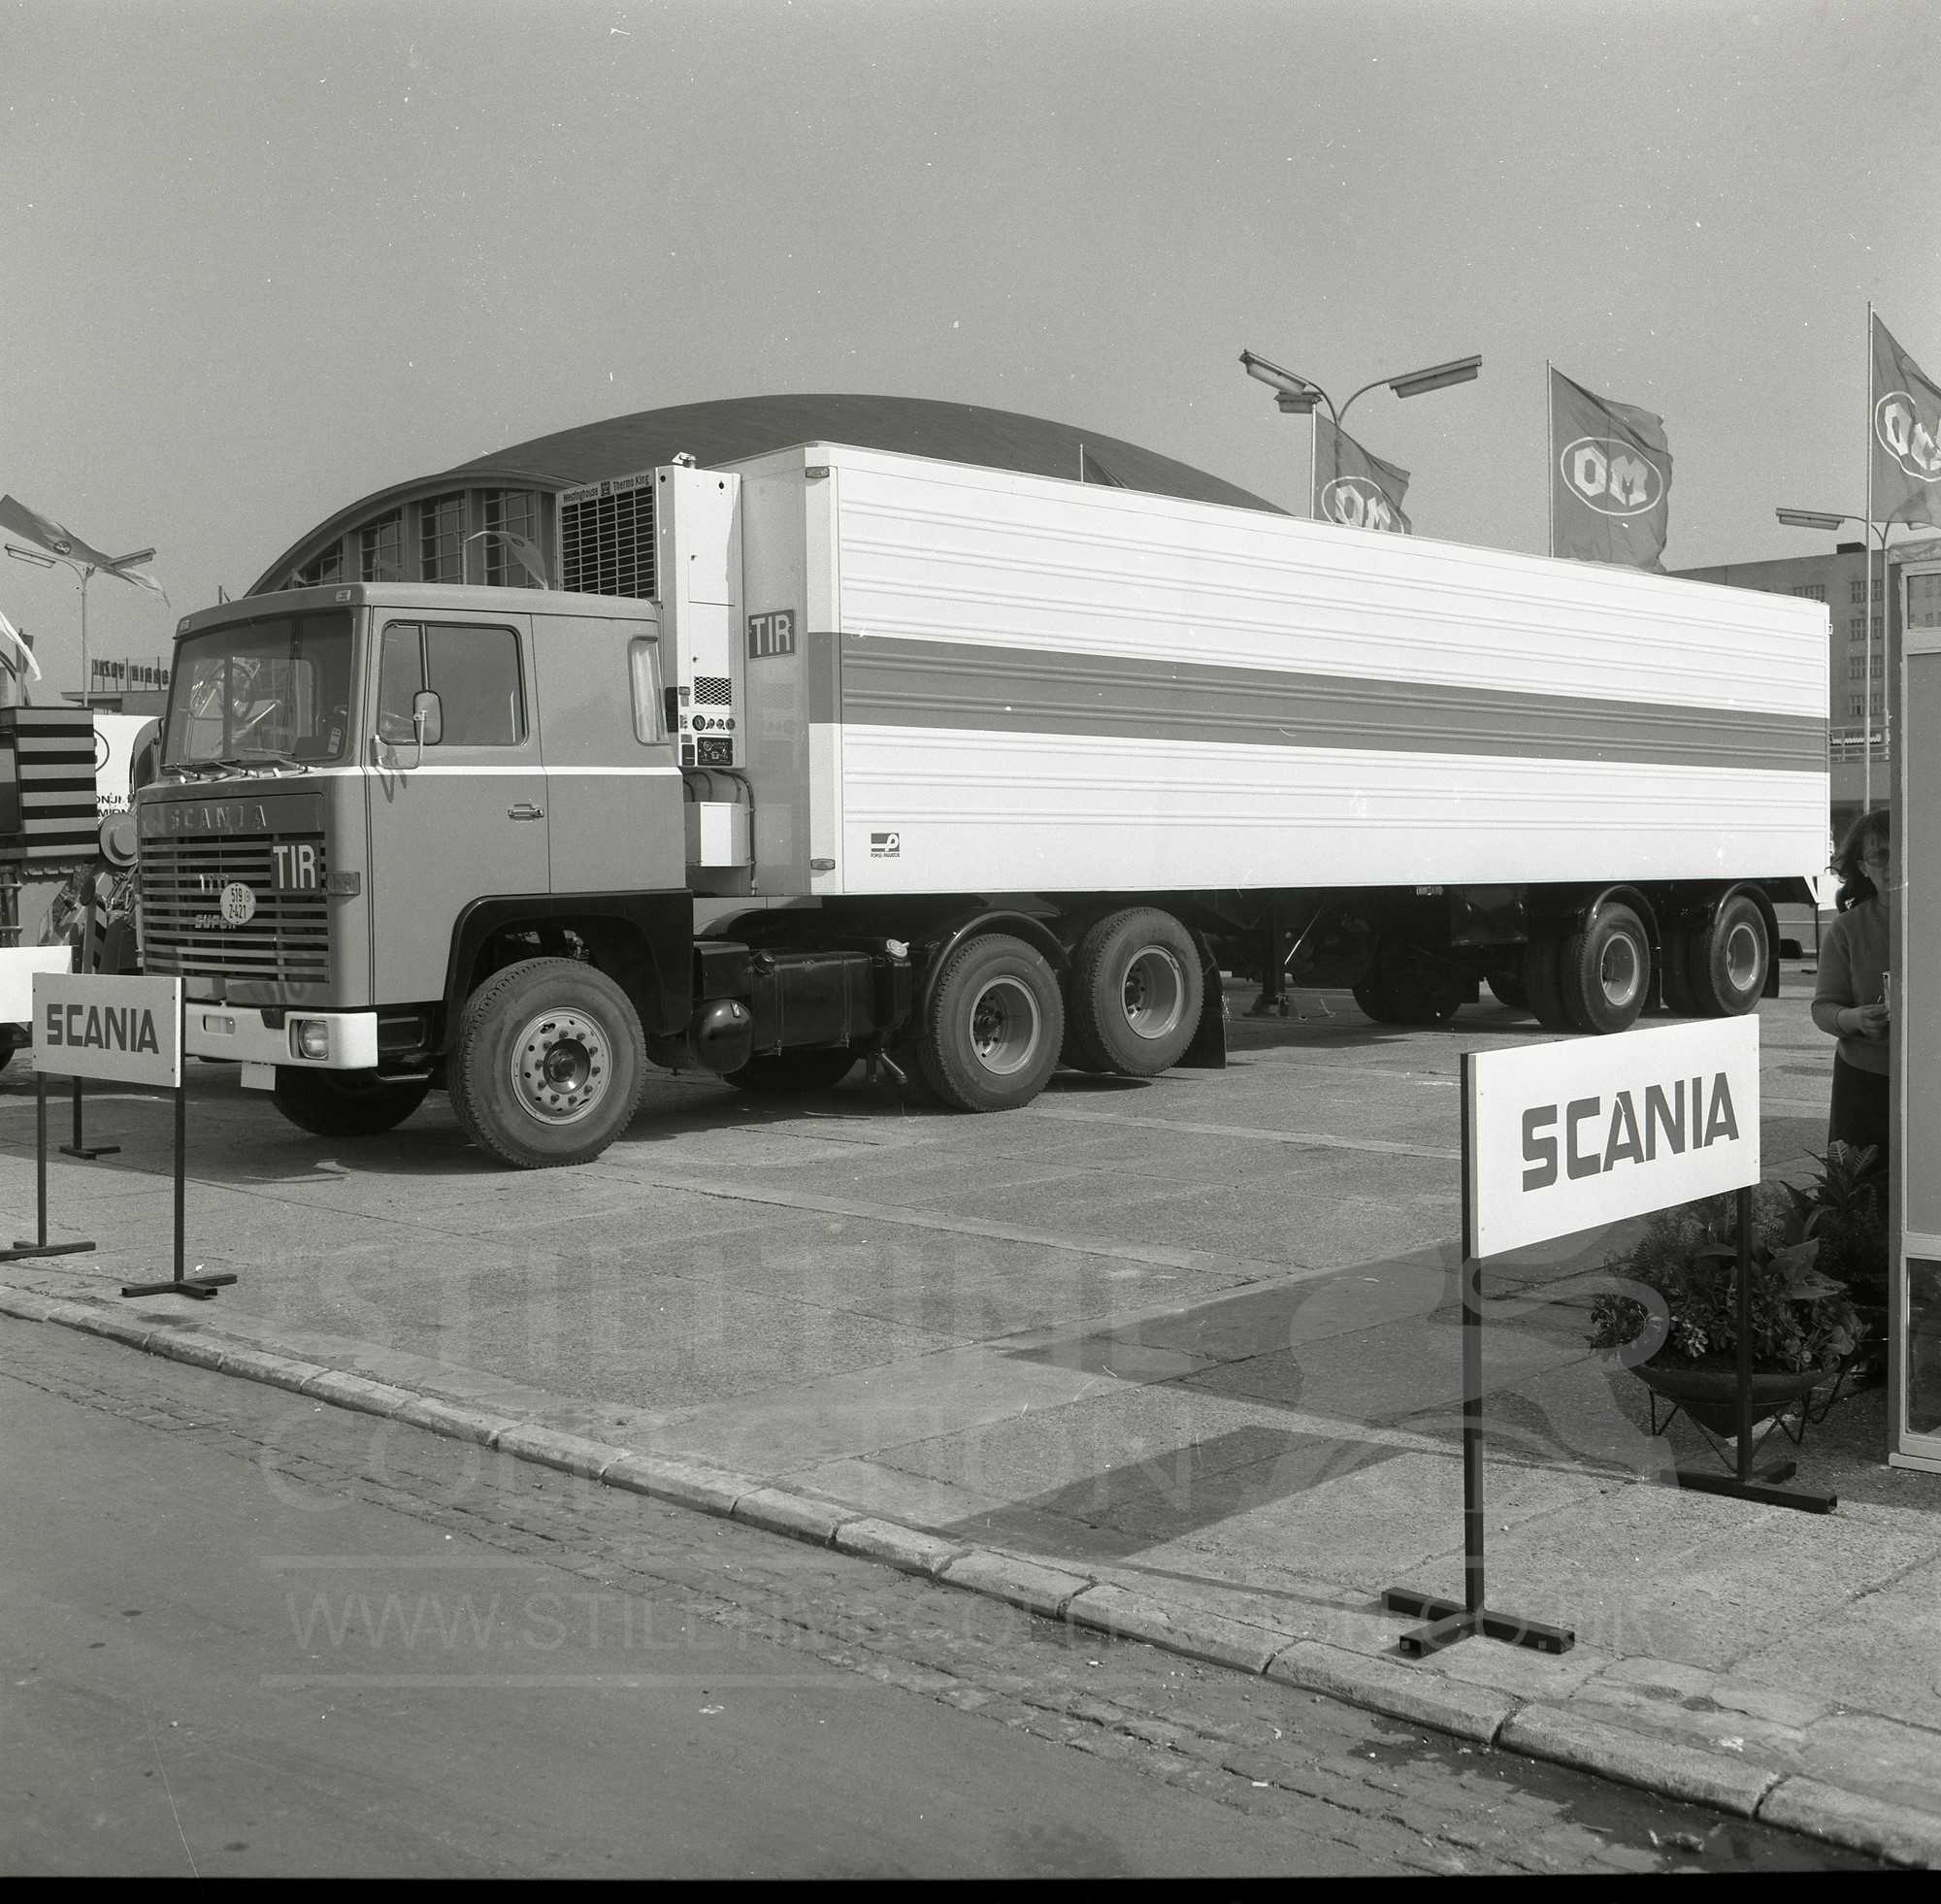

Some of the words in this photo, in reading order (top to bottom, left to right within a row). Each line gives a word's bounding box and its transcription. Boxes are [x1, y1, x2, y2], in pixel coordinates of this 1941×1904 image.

[612, 477, 634, 491] Thermo
[635, 473, 650, 486] King
[1573, 444, 1648, 507] OM
[751, 613, 792, 656] TIR
[170, 802, 268, 831] SCANIA
[273, 844, 316, 890] TIR
[47, 1002, 159, 1055] SCANIA
[1522, 1072, 1740, 1194] SCANIA
